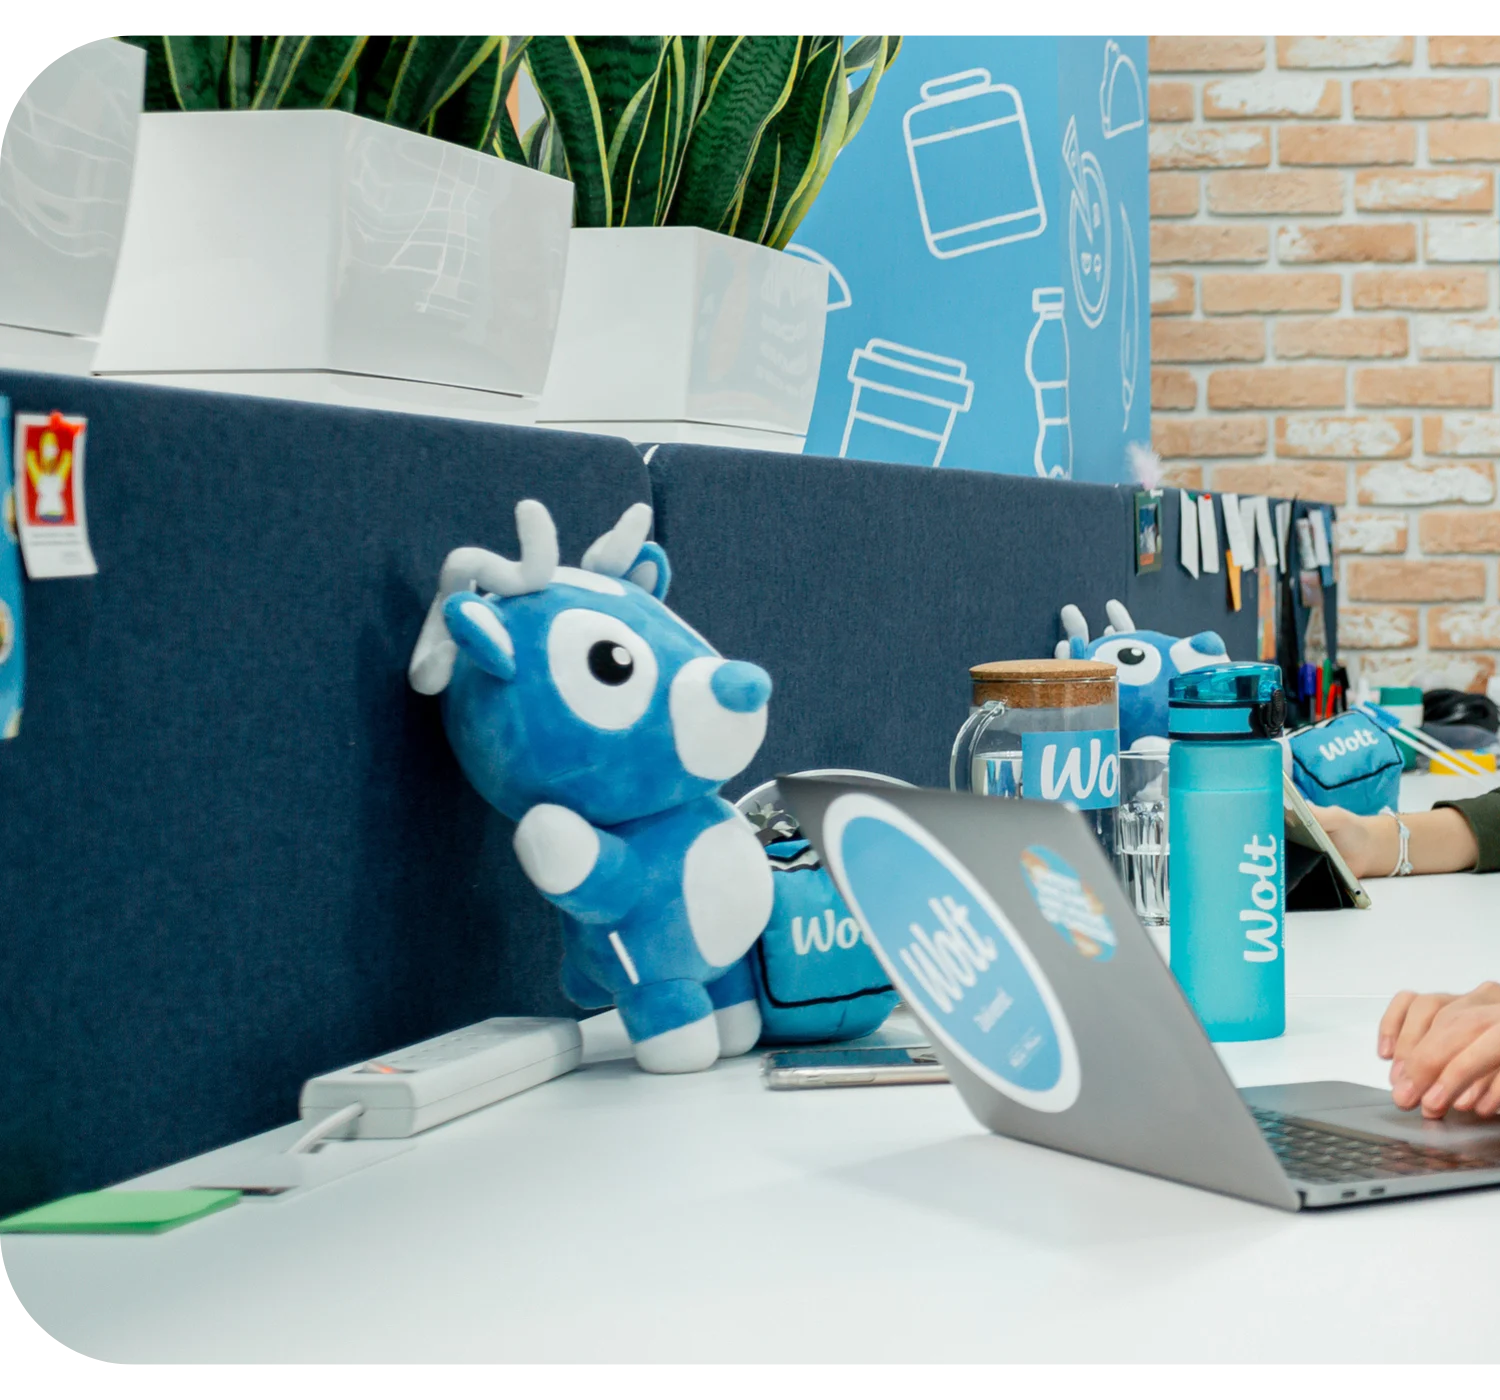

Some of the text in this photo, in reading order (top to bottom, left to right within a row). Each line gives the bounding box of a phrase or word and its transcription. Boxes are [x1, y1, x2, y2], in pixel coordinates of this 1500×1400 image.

[1040, 738, 1119, 800] Wo
[1319, 728, 1379, 761] Wolt
[1239, 834, 1278, 962] Wolt
[791, 908, 868, 955] Wo
[899, 895, 997, 1014] Wolt
